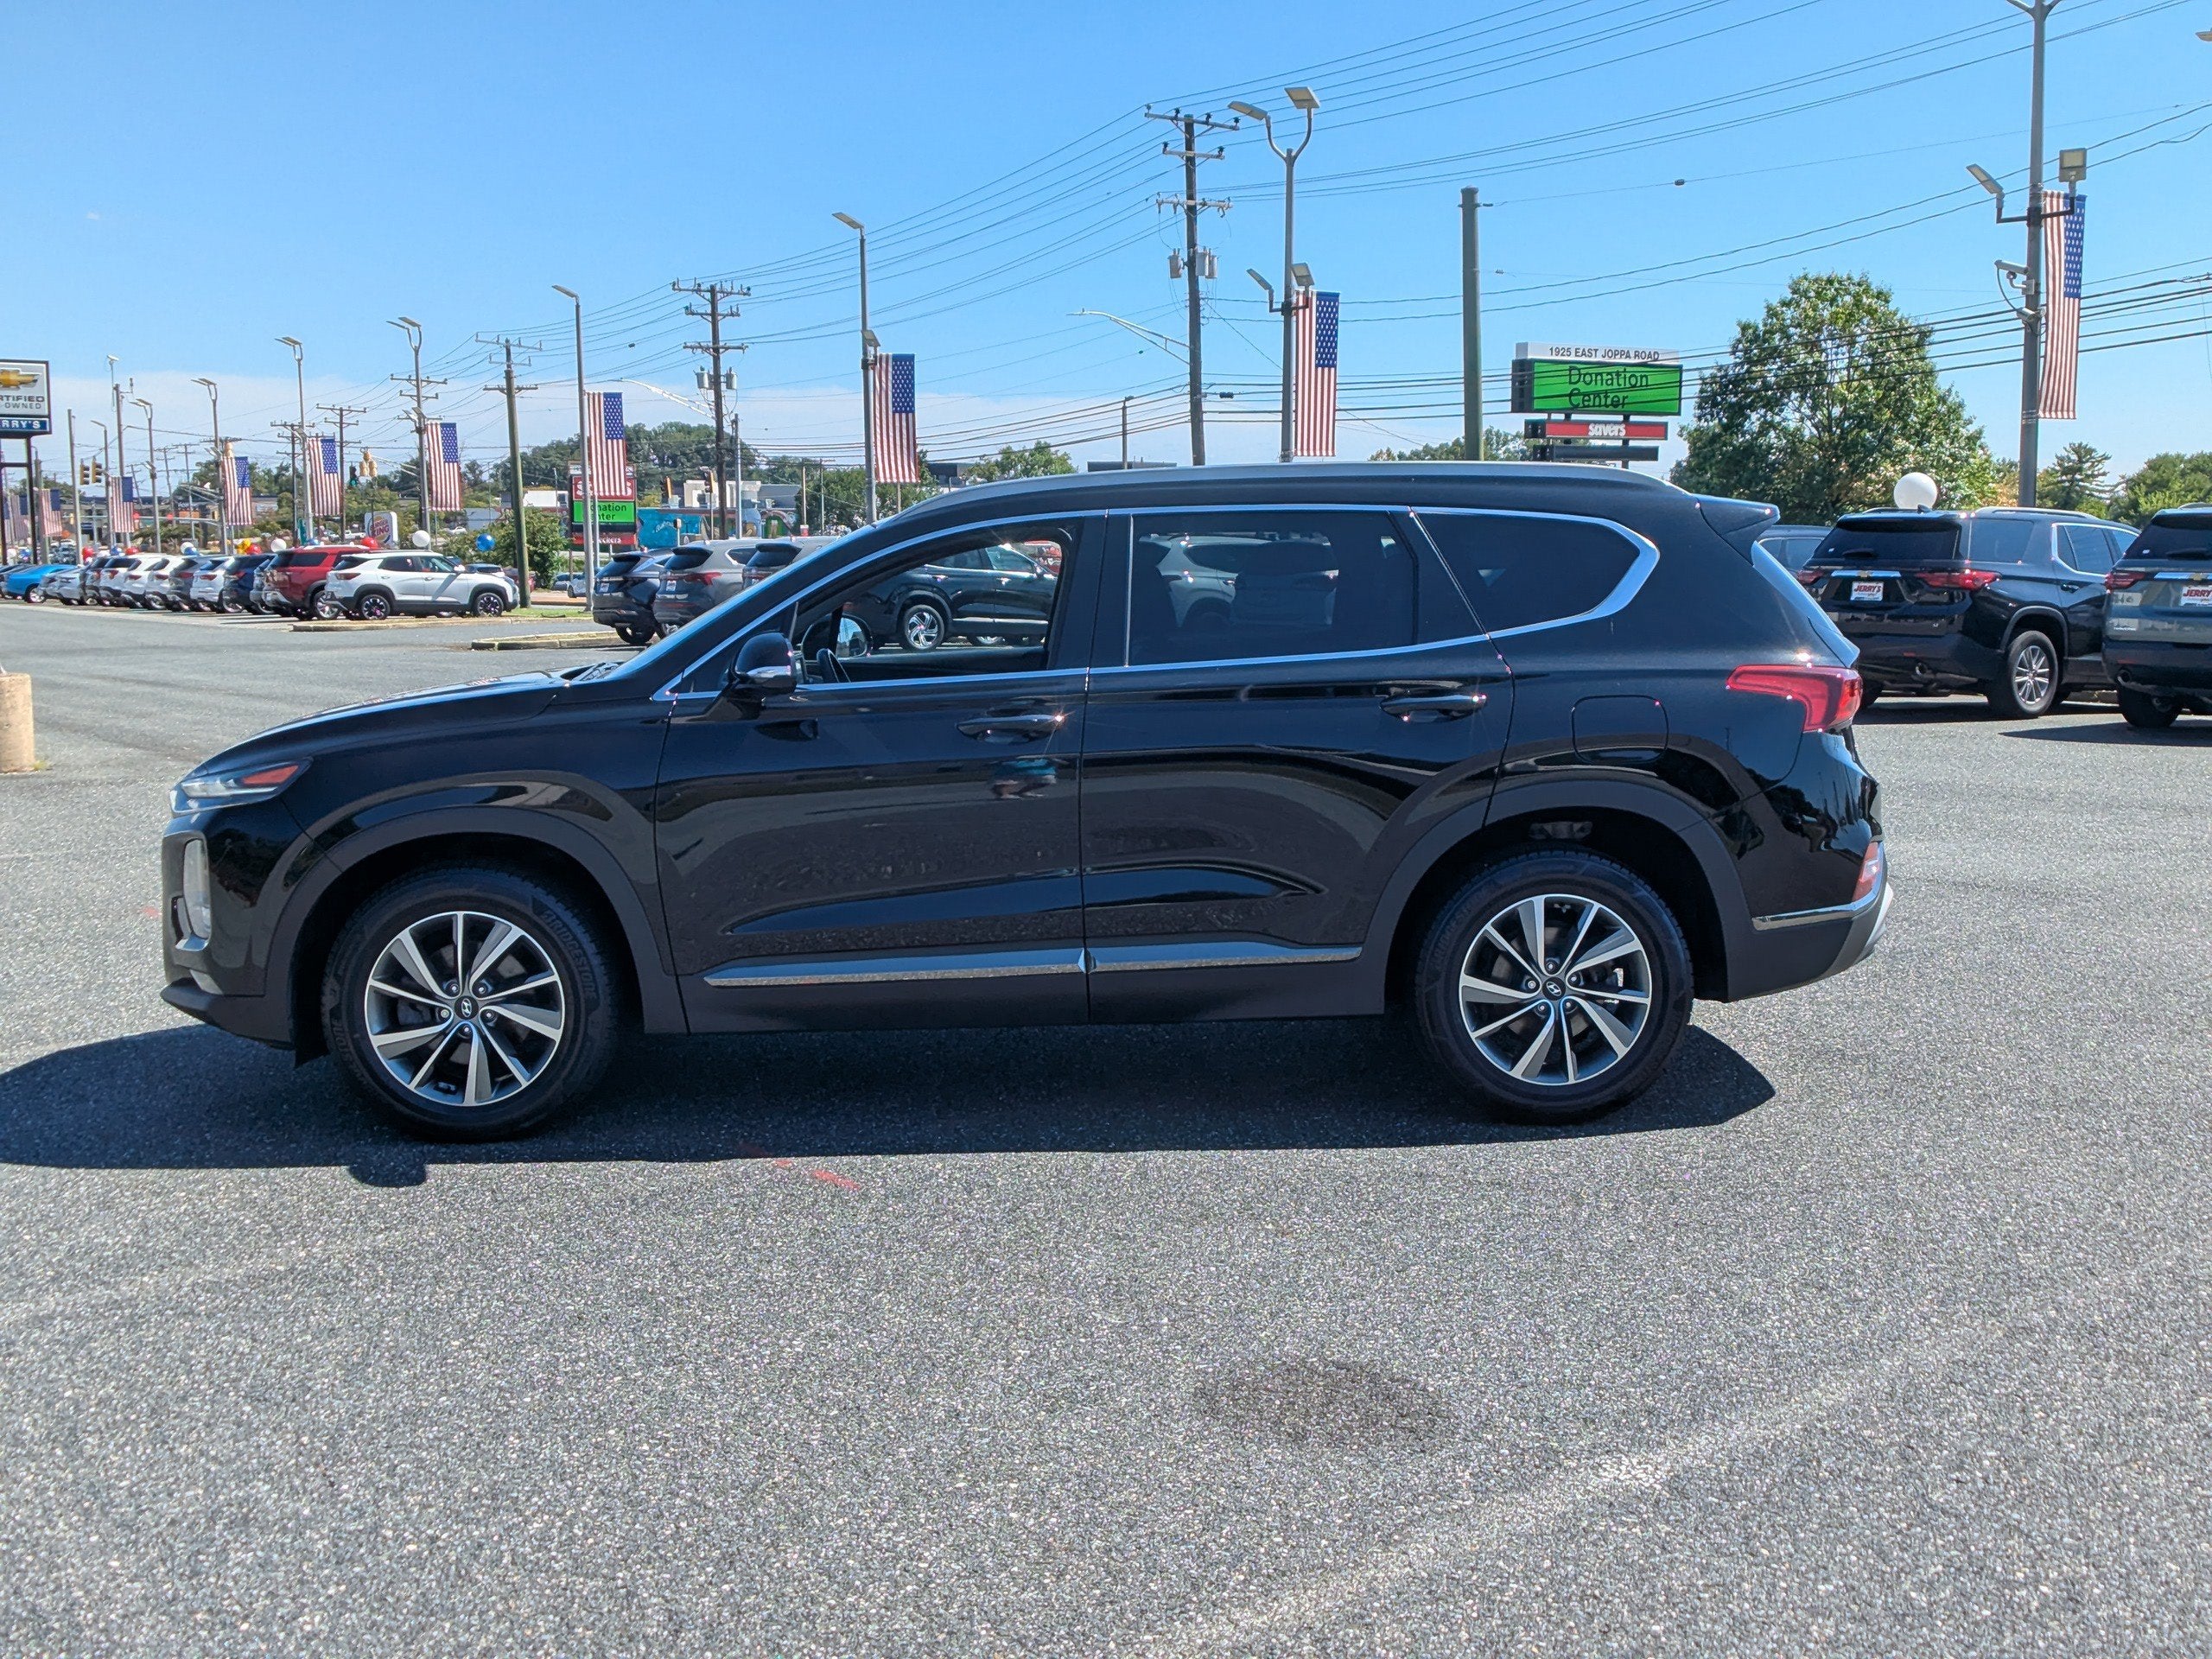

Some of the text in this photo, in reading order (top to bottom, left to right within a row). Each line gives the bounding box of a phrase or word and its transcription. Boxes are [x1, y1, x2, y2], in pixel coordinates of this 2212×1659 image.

[1548, 346, 1660, 360] 1925 EAST JOPPA ROAD
[1568, 365, 1649, 388] Donation
[1568, 388, 1630, 409] Center
[1588, 423, 1626, 436] savers
[590, 503, 627, 512] nation
